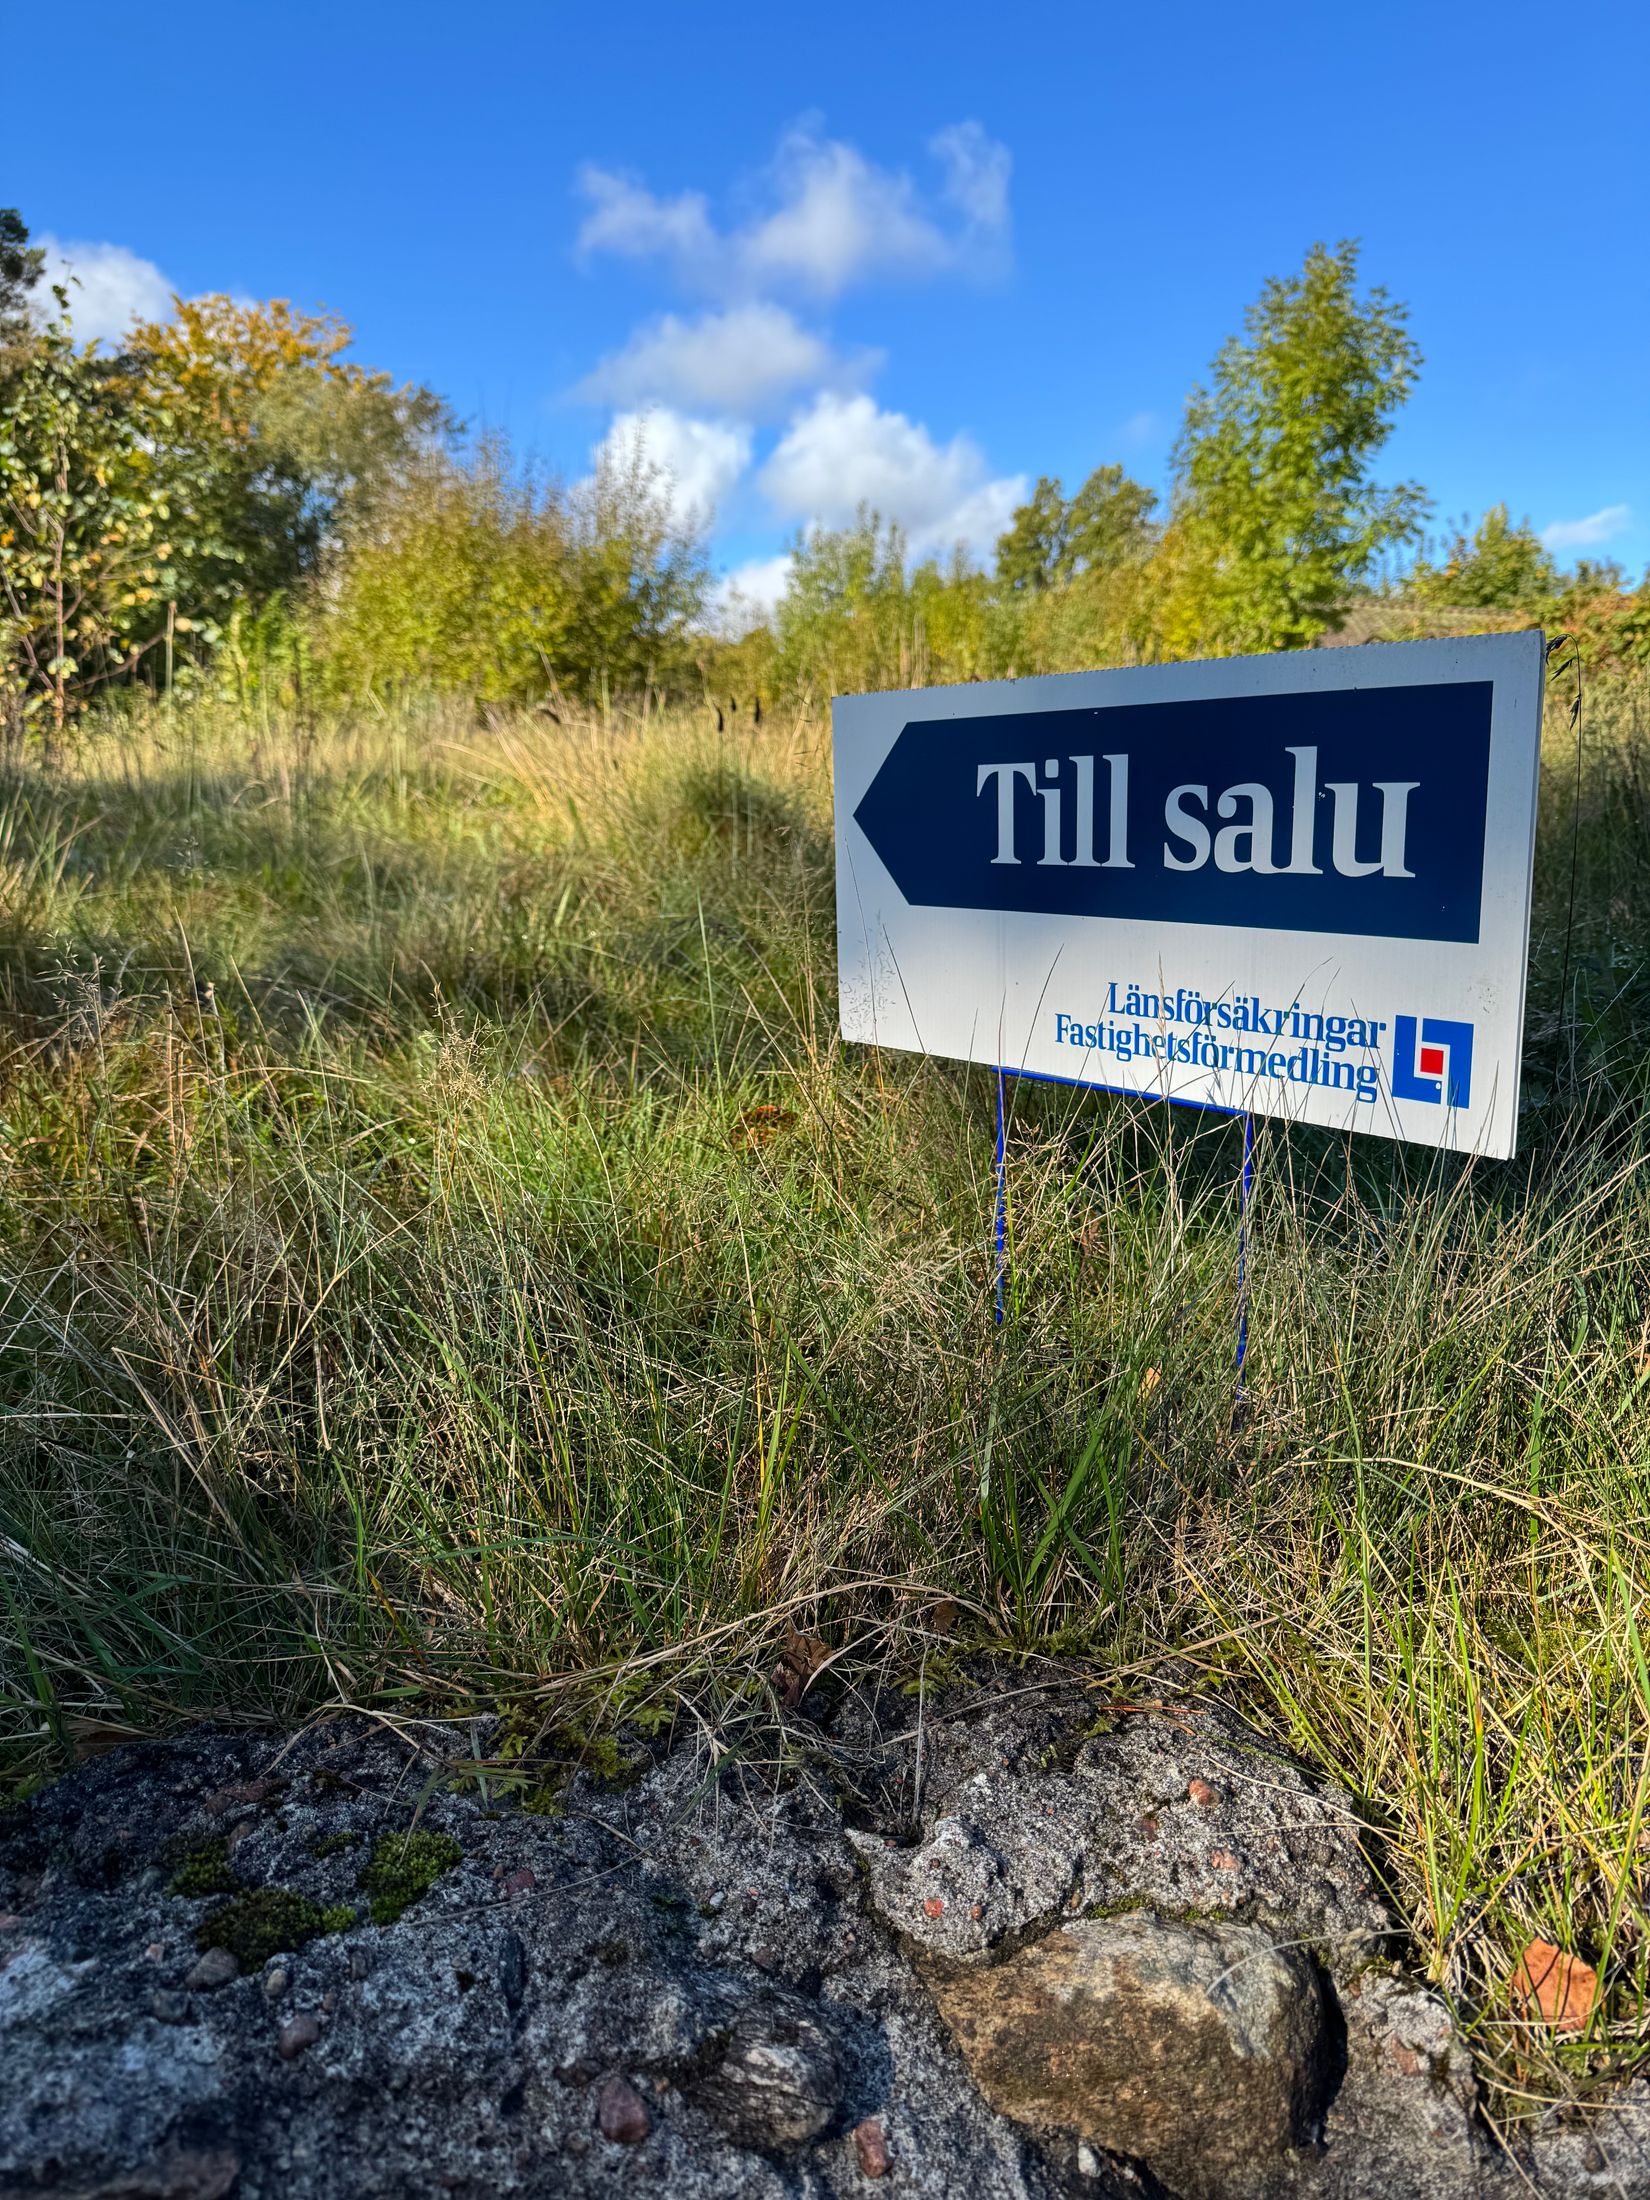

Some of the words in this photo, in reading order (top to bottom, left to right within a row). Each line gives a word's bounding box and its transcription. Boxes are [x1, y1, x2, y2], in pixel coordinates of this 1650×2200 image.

[976, 753, 1136, 869] Till
[1163, 745, 1421, 879] salu
[1054, 1012, 1380, 1104] Fastighetsförmedling
[1107, 981, 1387, 1053] Länsförsäkringar
